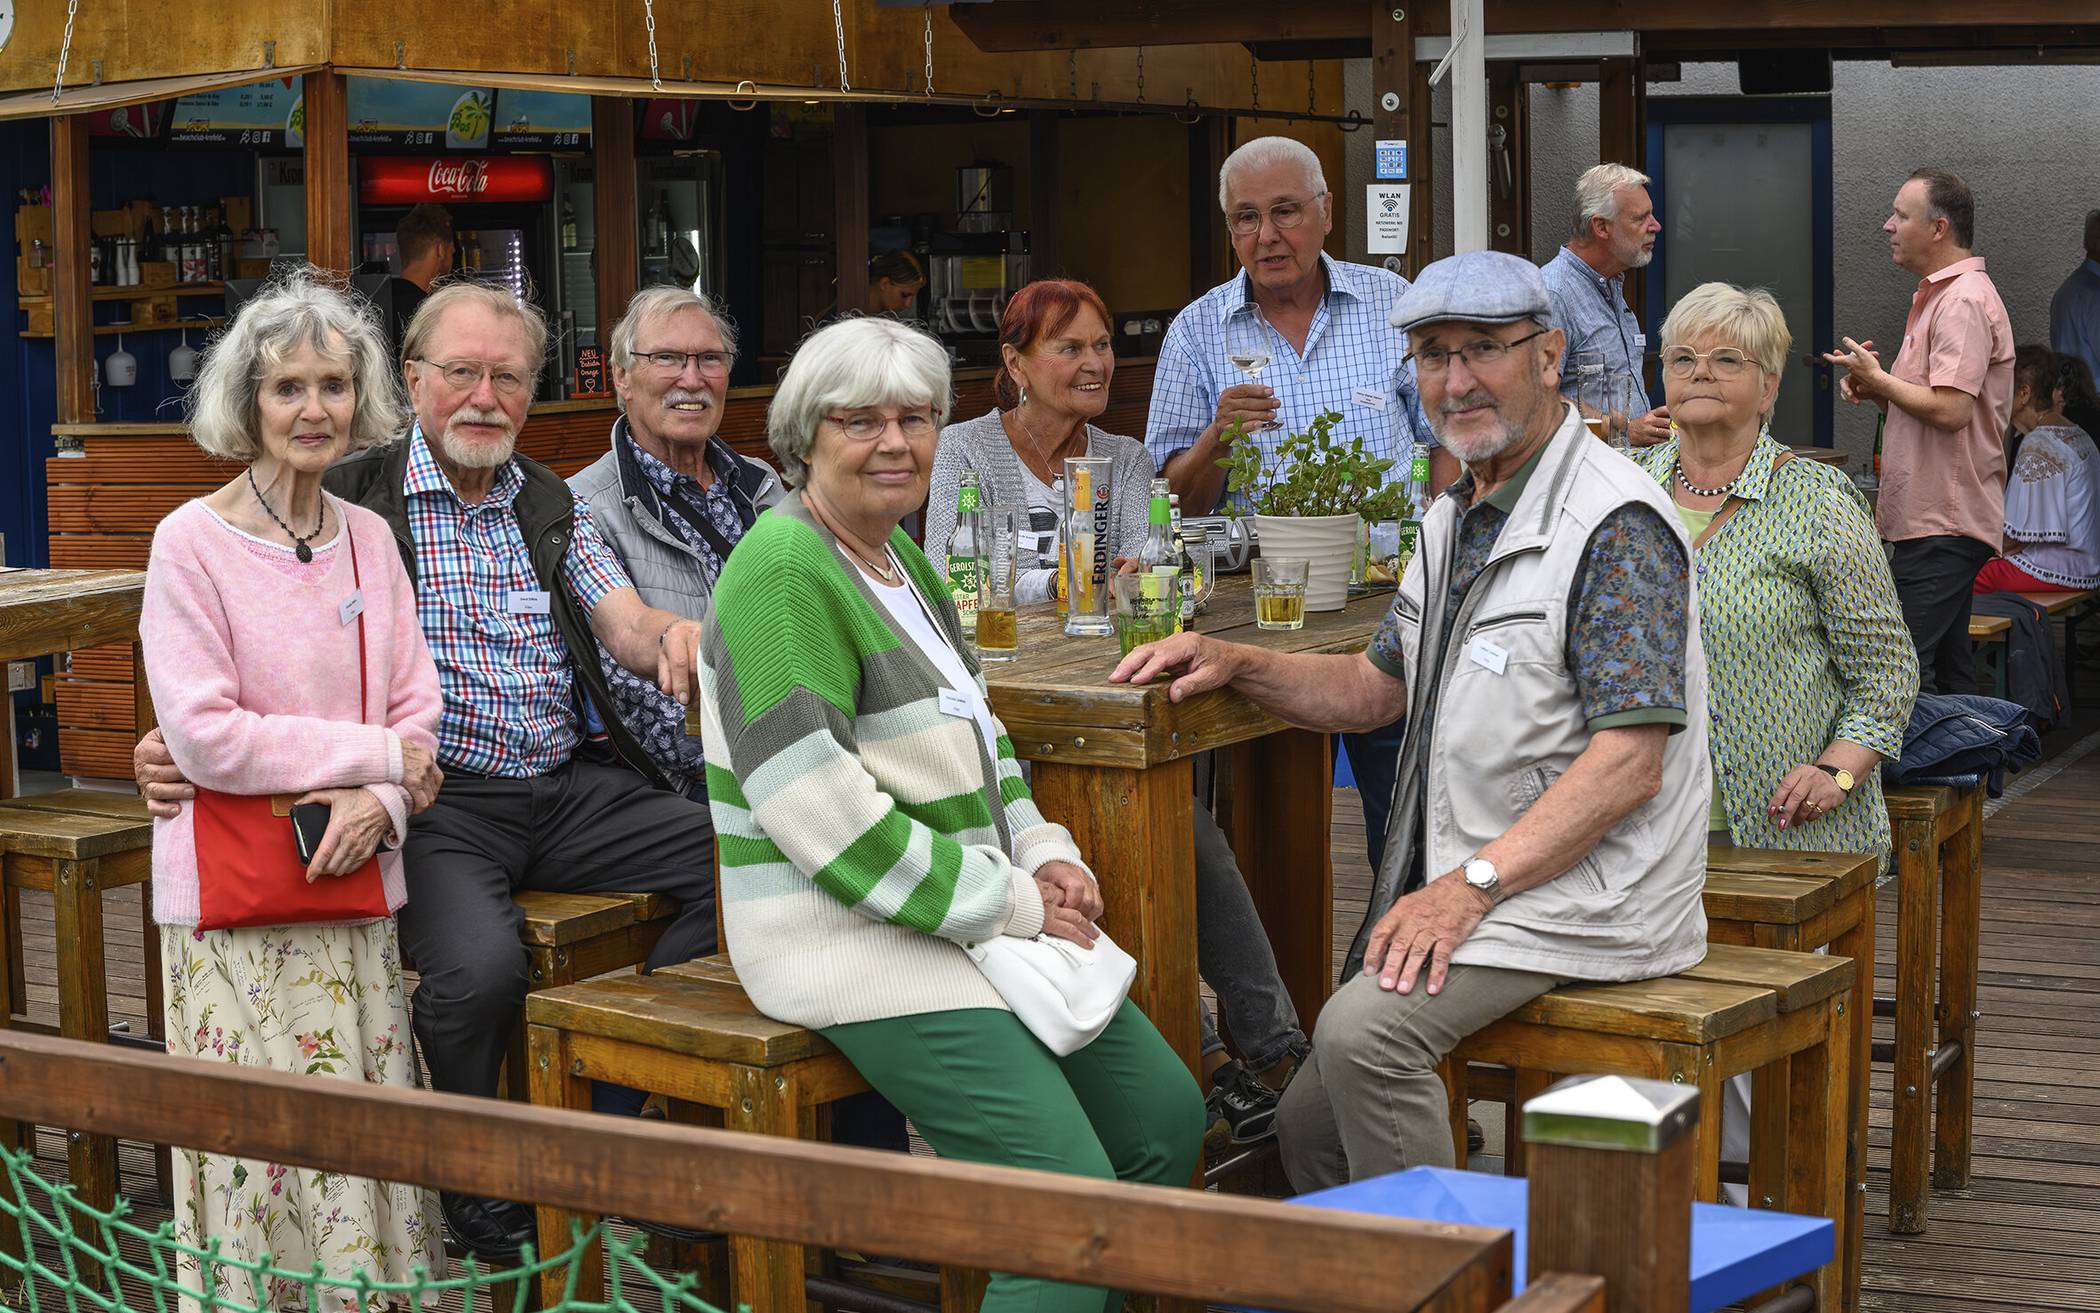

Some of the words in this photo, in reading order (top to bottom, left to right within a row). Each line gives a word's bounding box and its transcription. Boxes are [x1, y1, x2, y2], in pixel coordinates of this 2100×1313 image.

[428, 159, 489, 194] Coca-Cola
[1091, 500, 1109, 585] ERDINGER
[956, 599, 978, 611] APFE
